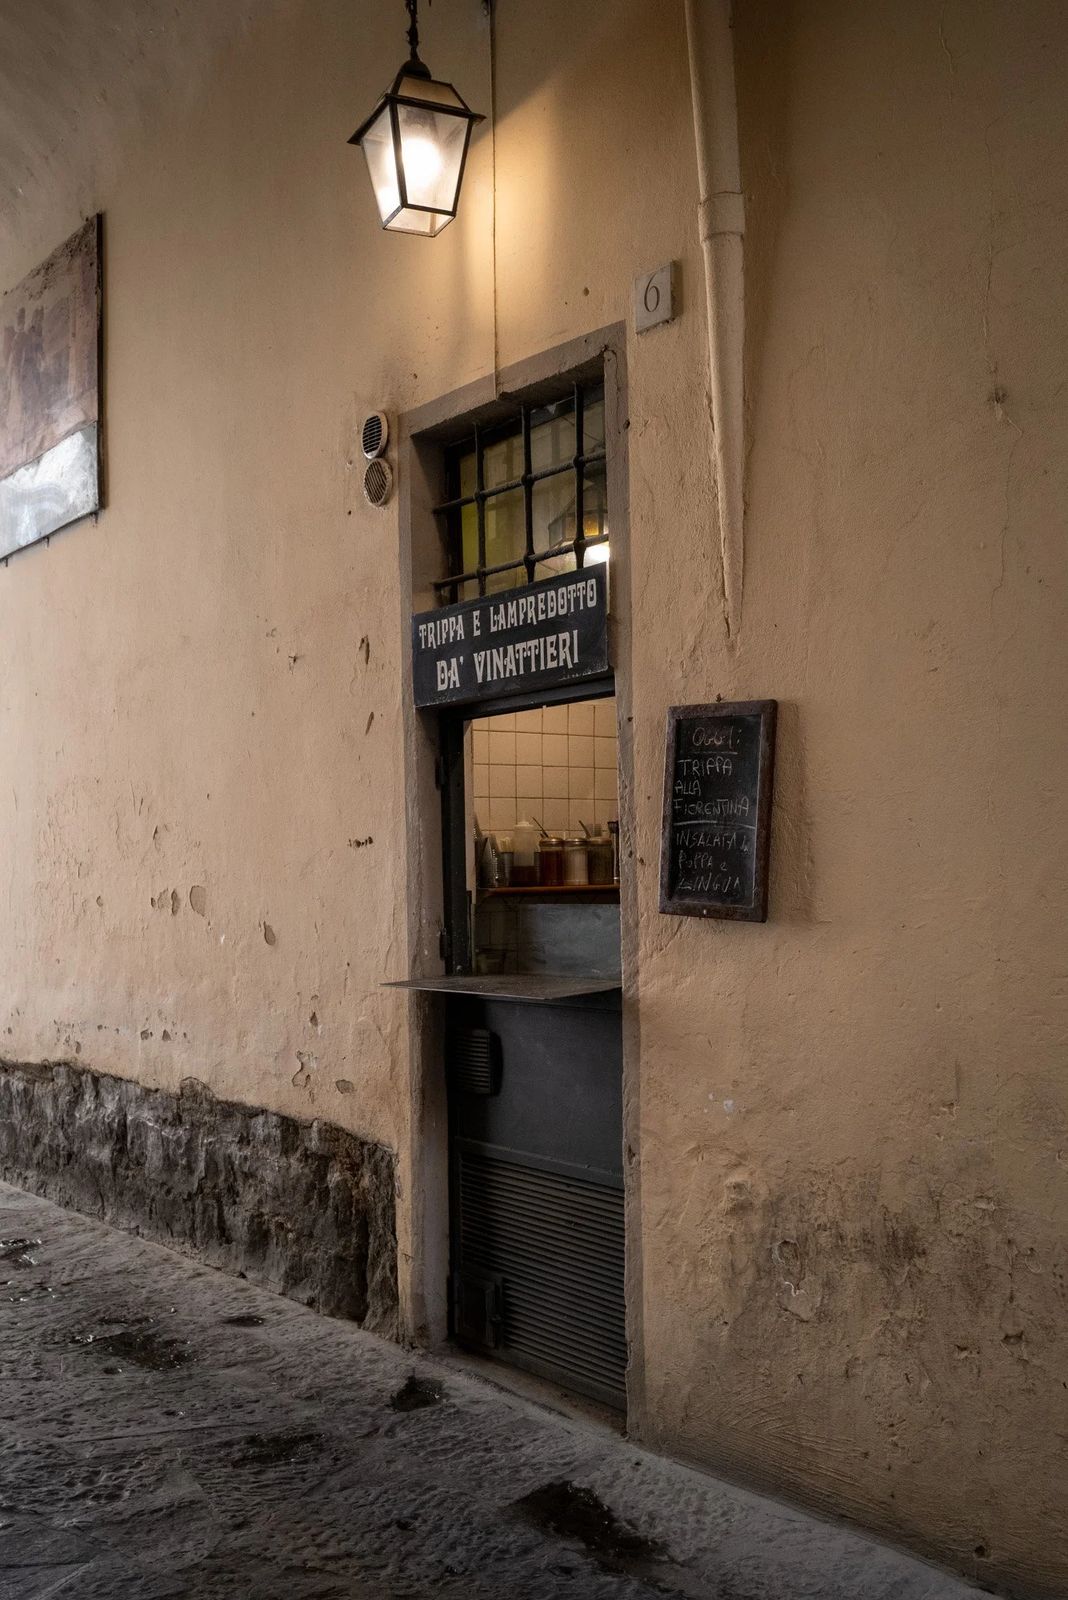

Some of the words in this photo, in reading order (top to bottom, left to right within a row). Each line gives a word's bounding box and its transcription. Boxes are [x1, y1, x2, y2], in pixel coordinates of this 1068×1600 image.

[644, 271, 660, 312] 6
[419, 614, 465, 649] TRIPPA
[473, 610, 480, 637] E
[489, 578, 597, 633] LAMPREDOTTO
[436, 656, 464, 691] DA'
[473, 629, 579, 684] VINATTIERI
[678, 756, 733, 777] TRIPPA
[674, 779, 702, 797] ALLA
[673, 795, 750, 817] FIORENTINA
